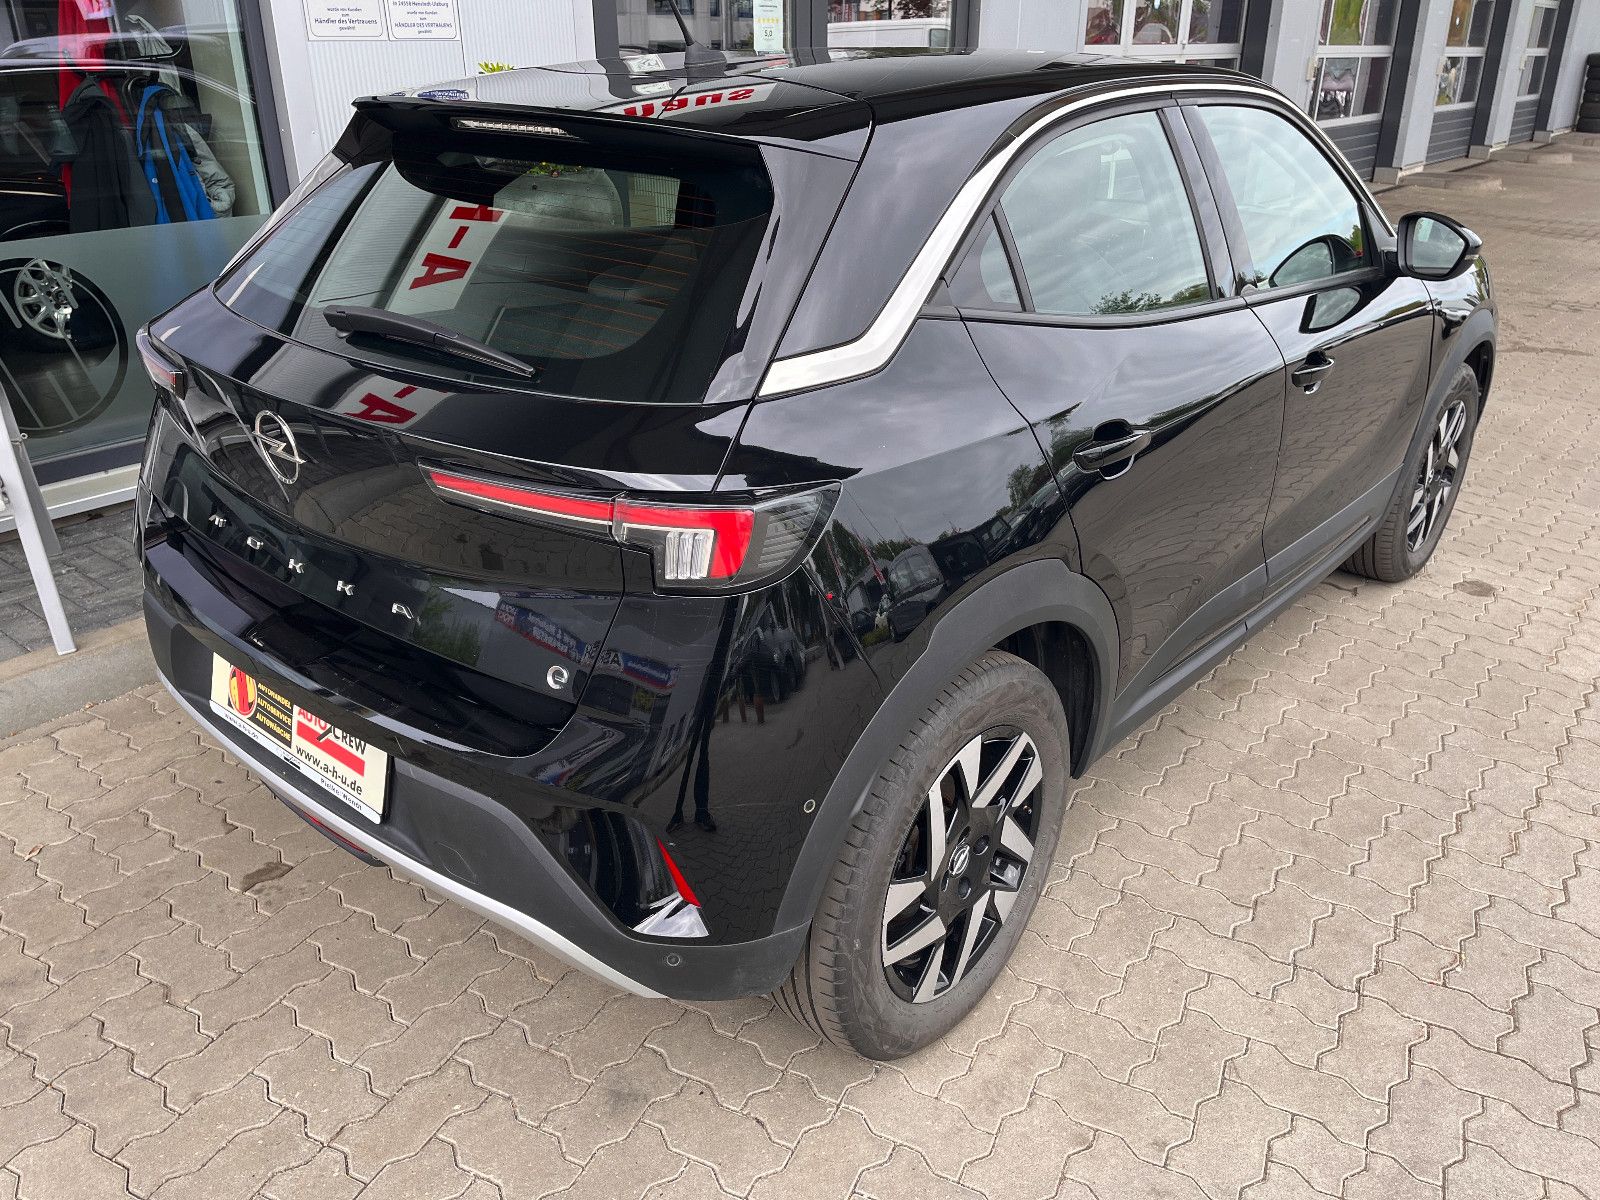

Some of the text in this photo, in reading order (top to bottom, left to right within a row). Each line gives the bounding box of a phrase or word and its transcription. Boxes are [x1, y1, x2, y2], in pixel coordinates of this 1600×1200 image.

[257, 682, 292, 710] AUTOHANDEL
[257, 697, 292, 726] AUTOSERVICE
[255, 712, 291, 742] AUTOWÄSCHE
[332, 725, 368, 756] CREW
[295, 744, 363, 796] www.a-h-u.de
